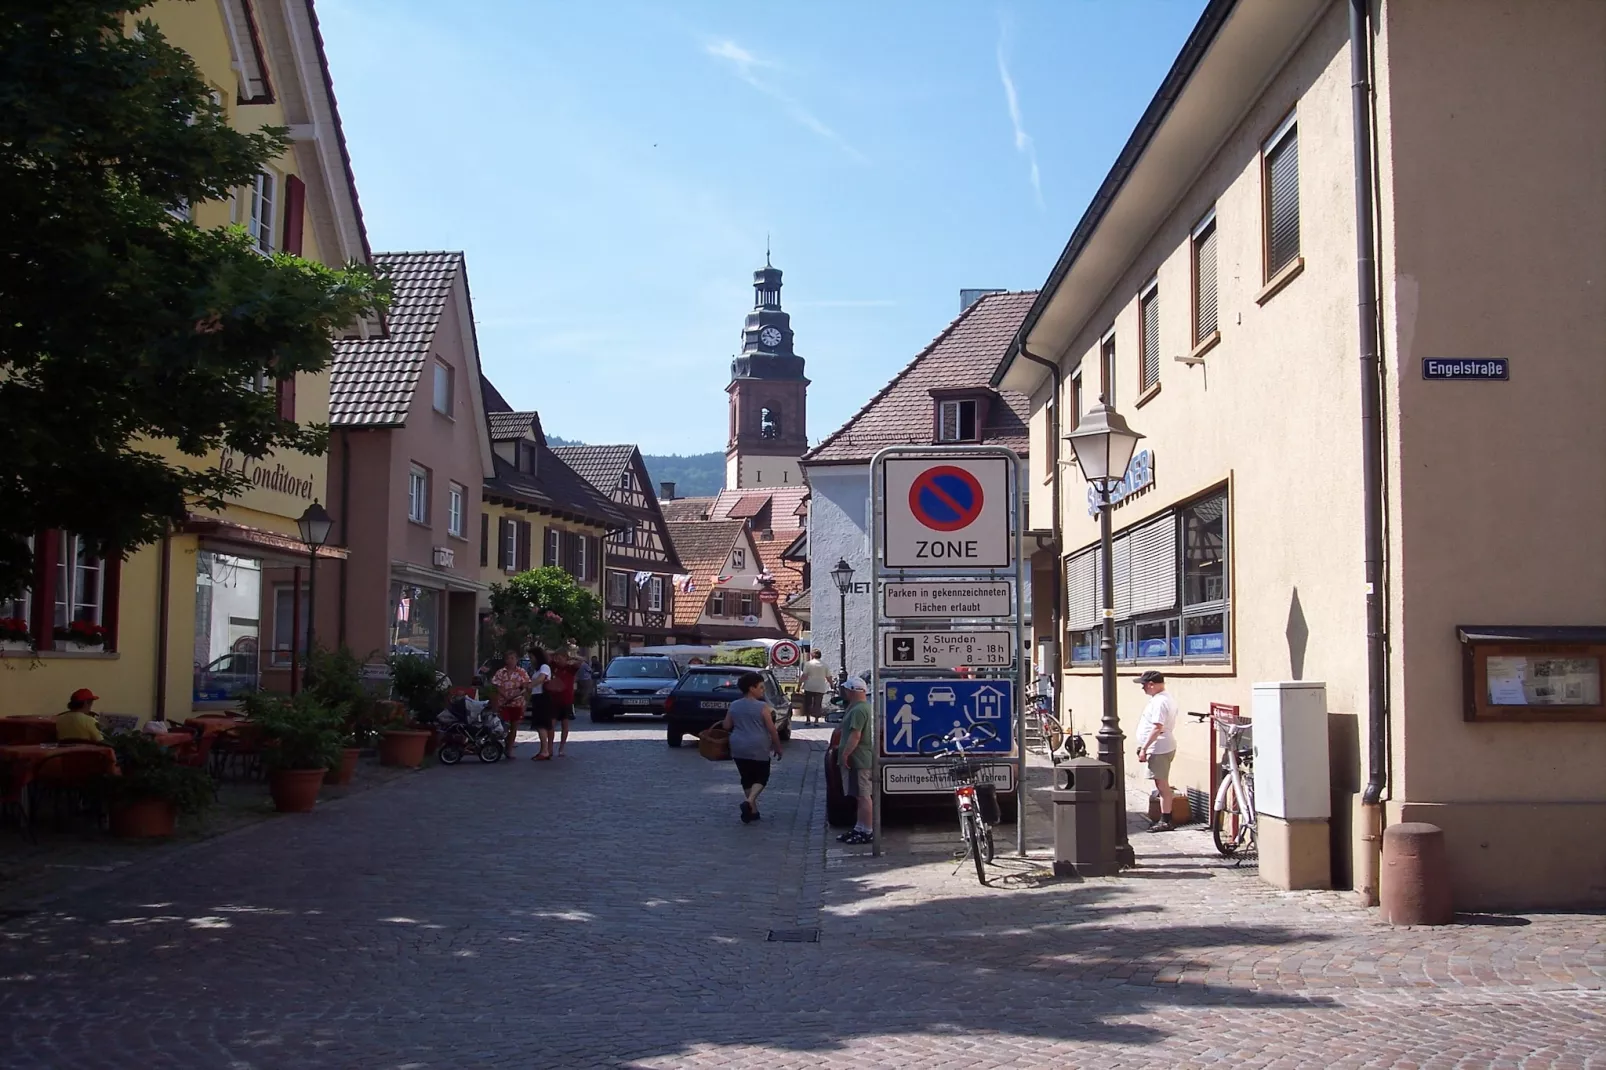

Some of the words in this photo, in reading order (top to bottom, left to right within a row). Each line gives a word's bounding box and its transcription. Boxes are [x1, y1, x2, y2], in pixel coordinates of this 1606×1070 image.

[1428, 361, 1503, 377] Engelstraße
[915, 540, 978, 558] ZONE
[888, 588, 917, 598] Parken
[920, 588, 929, 597] in
[932, 587, 1007, 599] gekennzeichneten
[914, 602, 947, 612] Flächen
[950, 602, 981, 612] erlaubt
[922, 635, 929, 644] 2
[934, 635, 976, 644] Stunden
[966, 644, 973, 653] 8
[923, 654, 936, 663] Sa
[966, 654, 973, 663] 8
